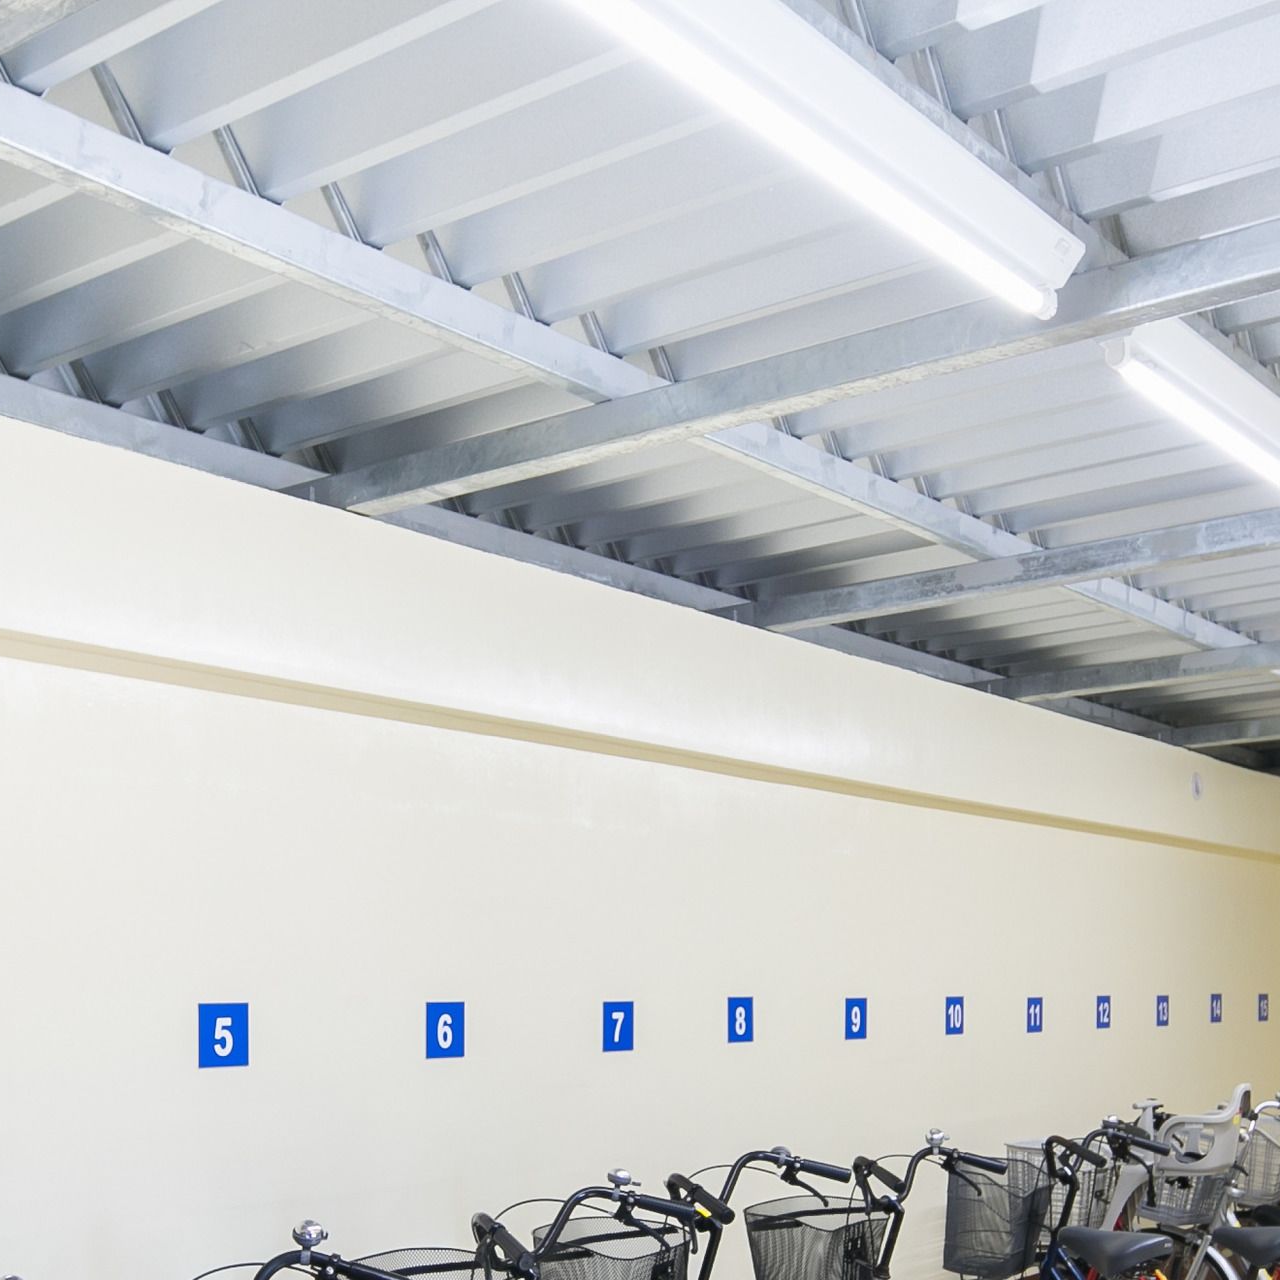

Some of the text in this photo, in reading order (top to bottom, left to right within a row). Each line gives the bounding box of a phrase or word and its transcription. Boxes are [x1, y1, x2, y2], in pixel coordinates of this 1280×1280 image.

[850, 1006, 861, 1033] 9
[947, 1004, 962, 1029] 10
[1028, 1004, 1041, 1026] 11
[1098, 1002, 1109, 1023] 12
[1158, 1001, 1168, 1021] 13
[1212, 999, 1221, 1018] 14
[1259, 999, 1268, 1017] 15
[437, 1013, 453, 1049] 6
[611, 1011, 625, 1043] 7
[735, 1006, 747, 1036] 8
[213, 1016, 234, 1057] 5
